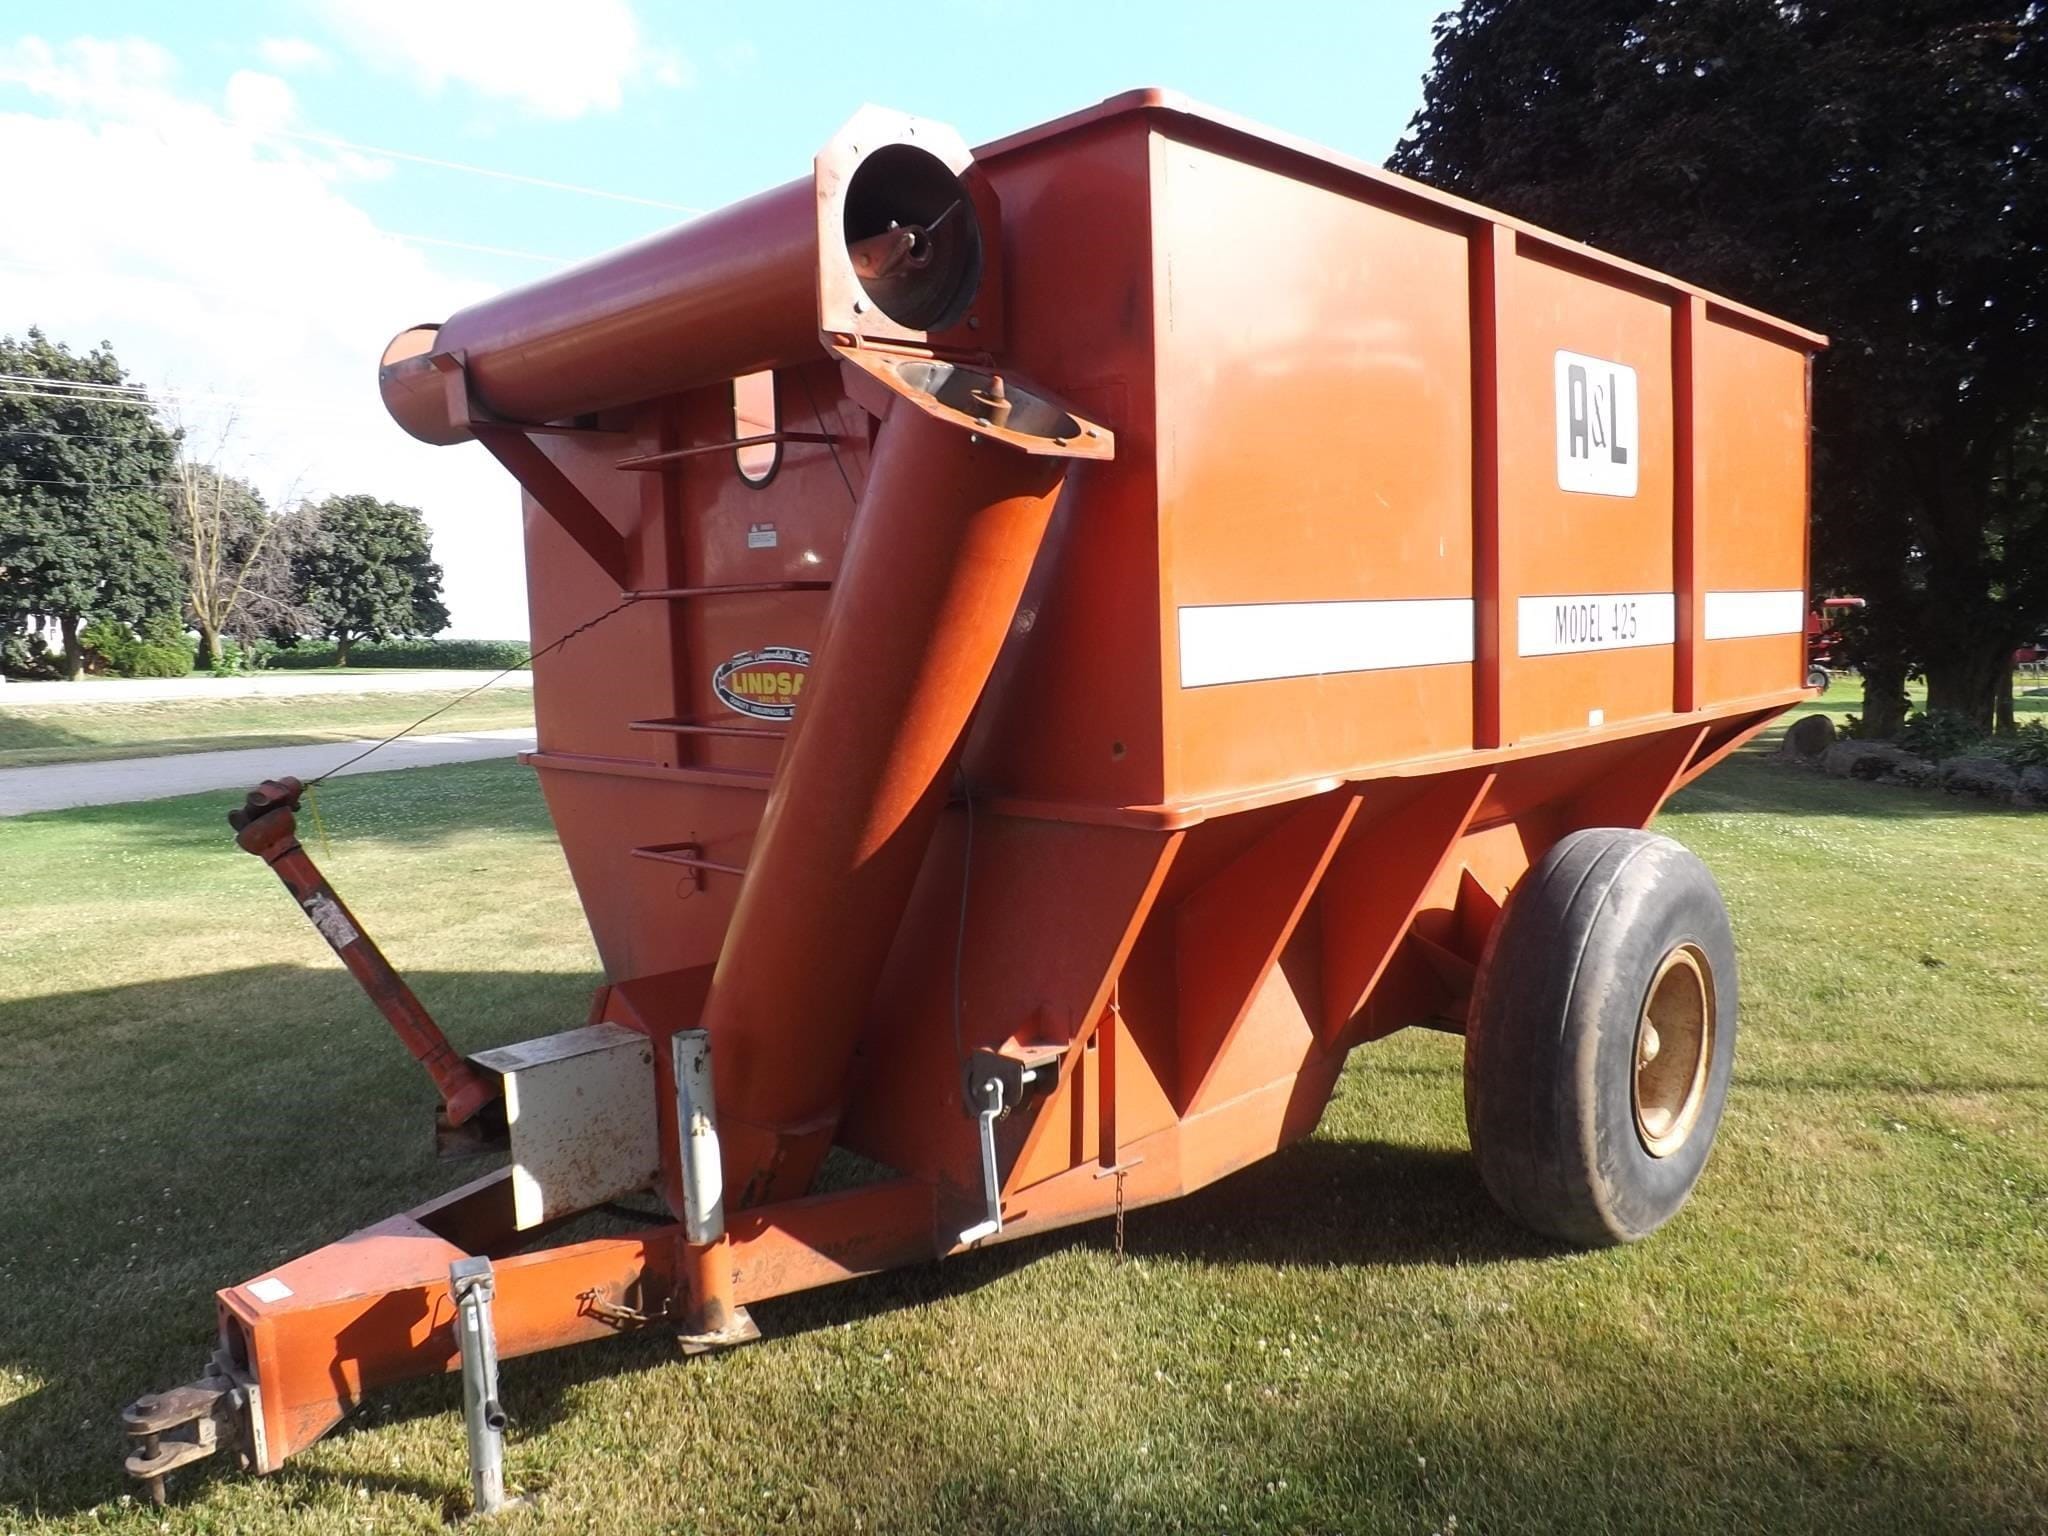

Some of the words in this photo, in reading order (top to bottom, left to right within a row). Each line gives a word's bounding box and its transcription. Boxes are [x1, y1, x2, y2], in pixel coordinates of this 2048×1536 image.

[1568, 364, 1627, 465] A&L
[1555, 604, 1603, 644] MODEL
[1612, 602, 1637, 640] 425
